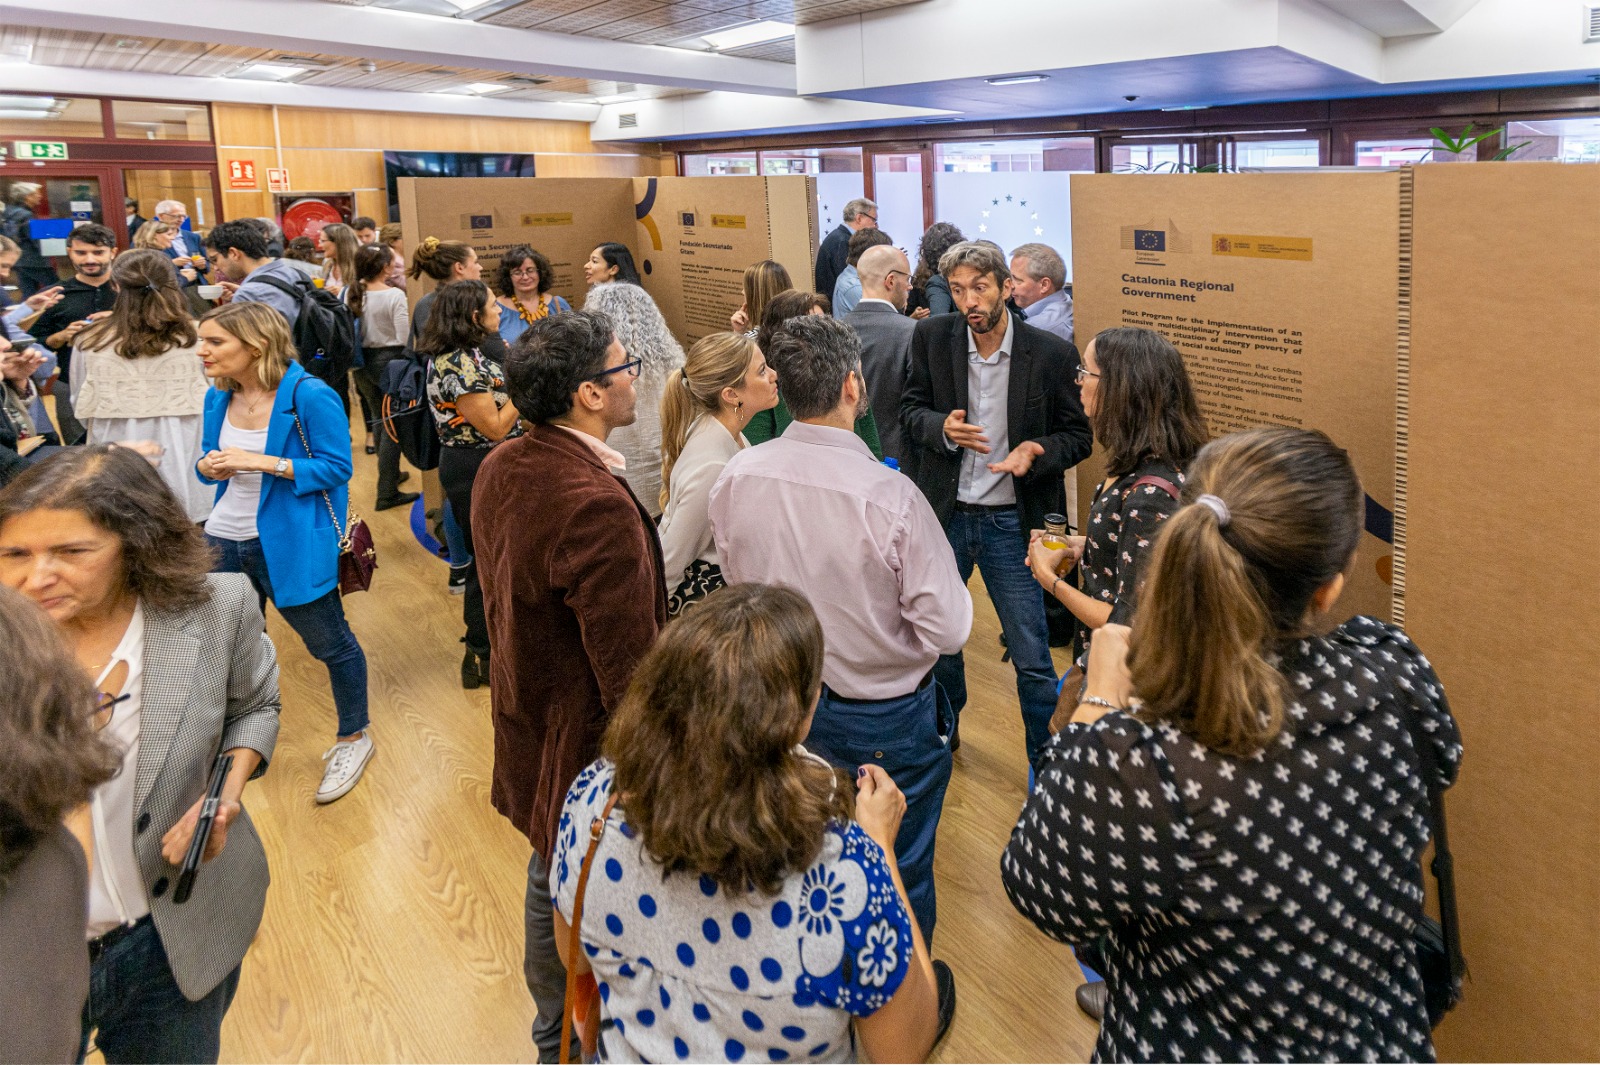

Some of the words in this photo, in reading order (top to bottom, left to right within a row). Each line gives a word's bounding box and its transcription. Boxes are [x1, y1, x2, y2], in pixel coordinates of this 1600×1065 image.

[1121, 273, 1176, 287] Catalonia
[1180, 278, 1234, 292] Regional
[1121, 286, 1196, 302] Government
[1122, 309, 1138, 317] Pilot
[1141, 311, 1173, 321] Program
[1191, 317, 1204, 325] the
[1207, 319, 1274, 333] Implementation
[1122, 317, 1153, 327] intensive
[1157, 322, 1220, 337] multidisciplinary
[1225, 330, 1278, 343] intervention
[1283, 337, 1302, 346] that
[1173, 332, 1207, 342] situation
[1222, 339, 1251, 349] energy
[1254, 343, 1289, 354] poverty
[1182, 341, 1203, 350] social
[1204, 344, 1242, 355] exclusion
[1190, 361, 1215, 371] different
[1290, 377, 1303, 385] the
[1212, 357, 1251, 367] intervention
[1255, 363, 1269, 371] that
[1272, 367, 1302, 376] combats
[1196, 371, 1226, 382] efficiency
[1234, 405, 1256, 414] impact
[1272, 413, 1303, 425] reducing
